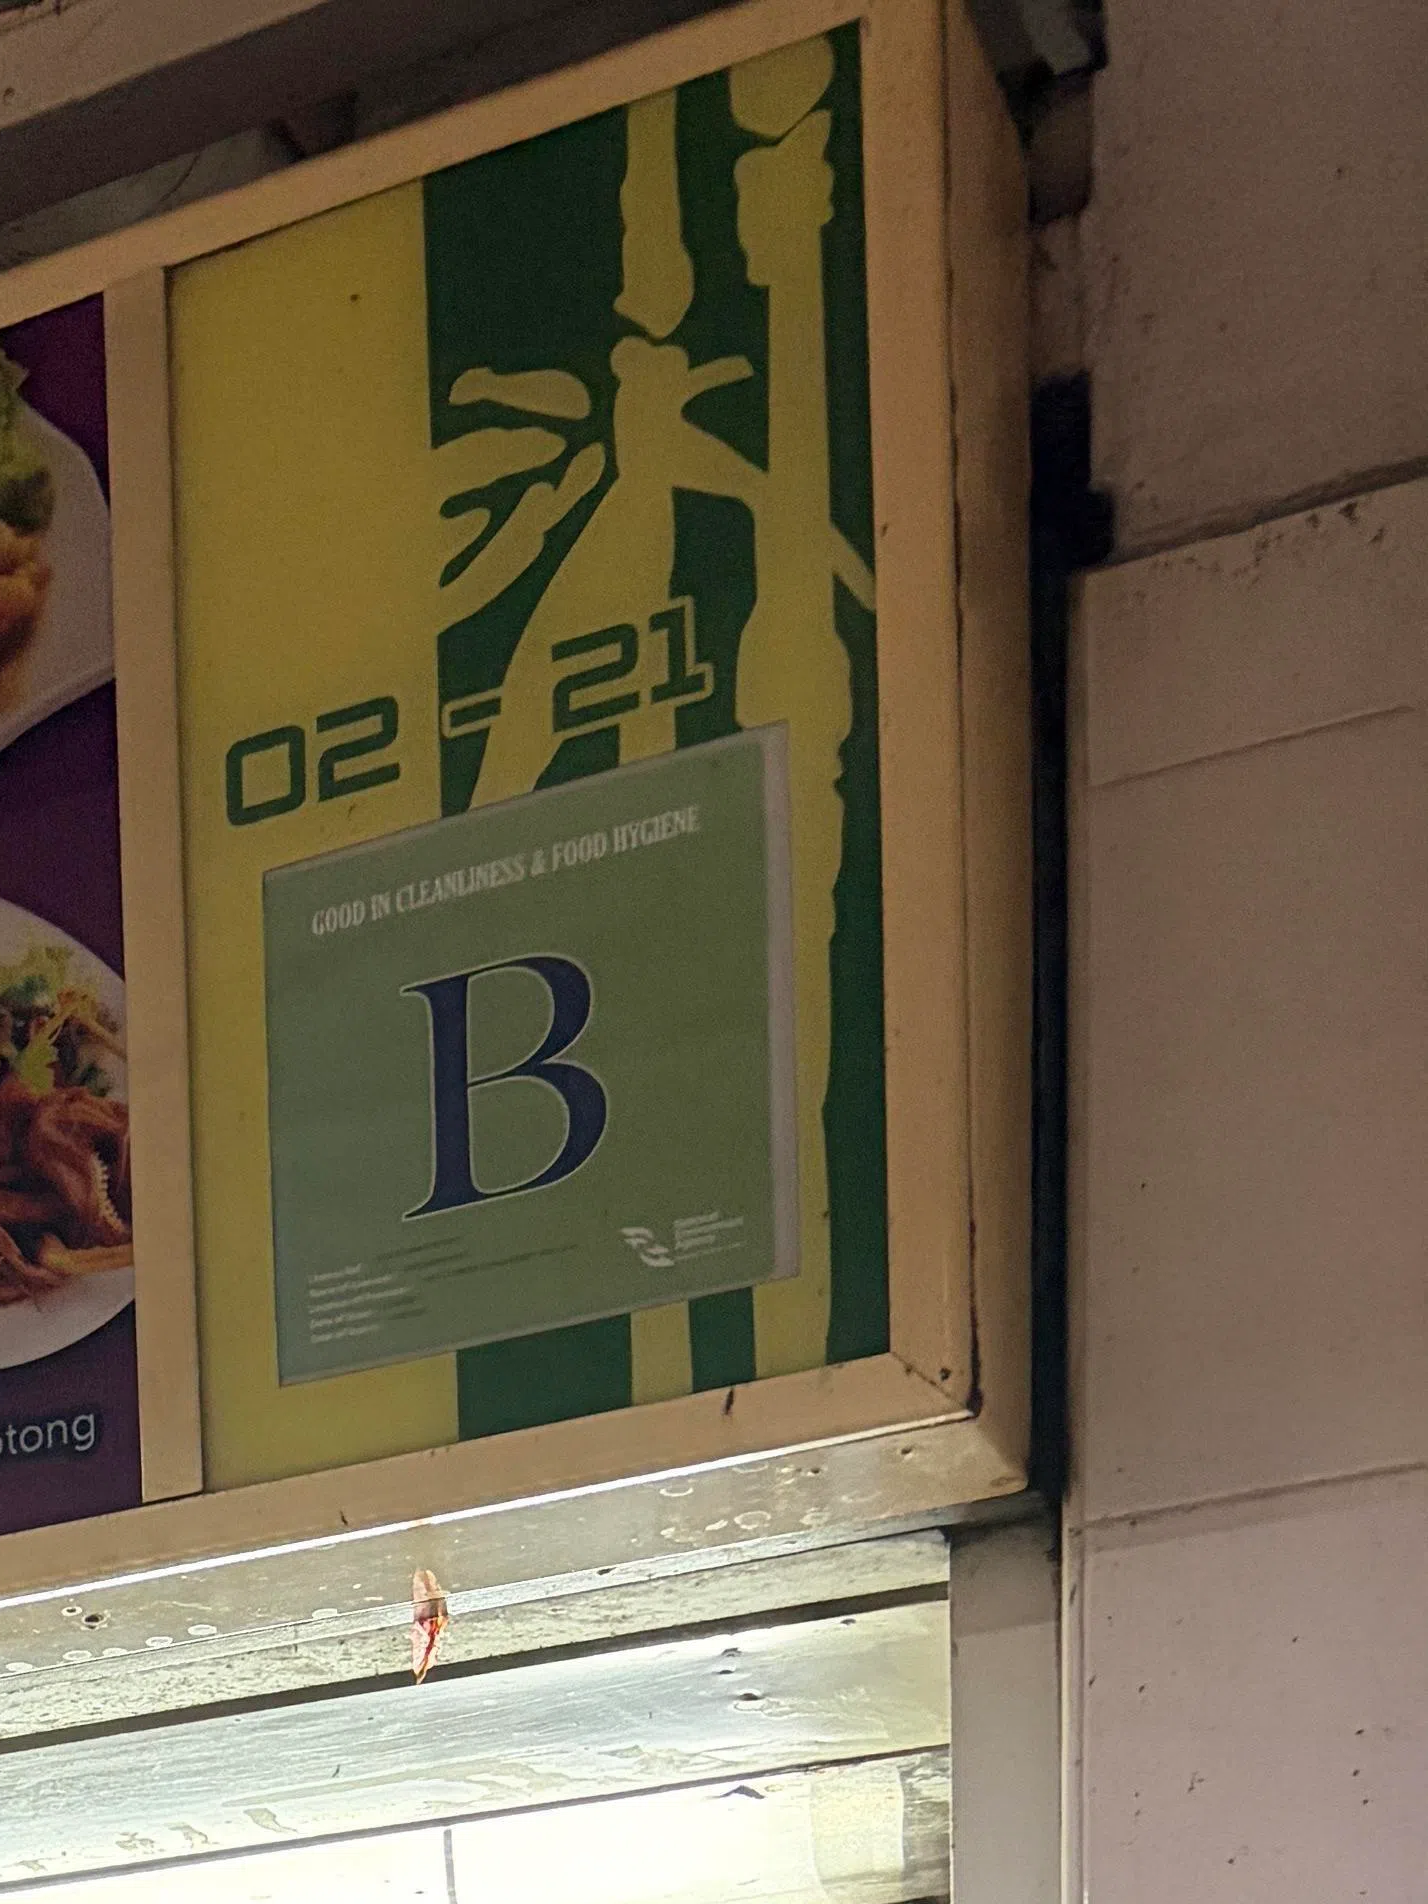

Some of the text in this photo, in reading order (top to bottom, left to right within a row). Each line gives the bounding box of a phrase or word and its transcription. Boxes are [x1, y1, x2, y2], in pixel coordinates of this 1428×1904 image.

[311, 900, 365, 935] GOOD
[371, 892, 393, 921] IN
[395, 852, 526, 912] CLEANLINESS
[551, 831, 606, 873] FOOD
[612, 802, 702, 854] HYGIENE
[400, 951, 609, 1223] B
